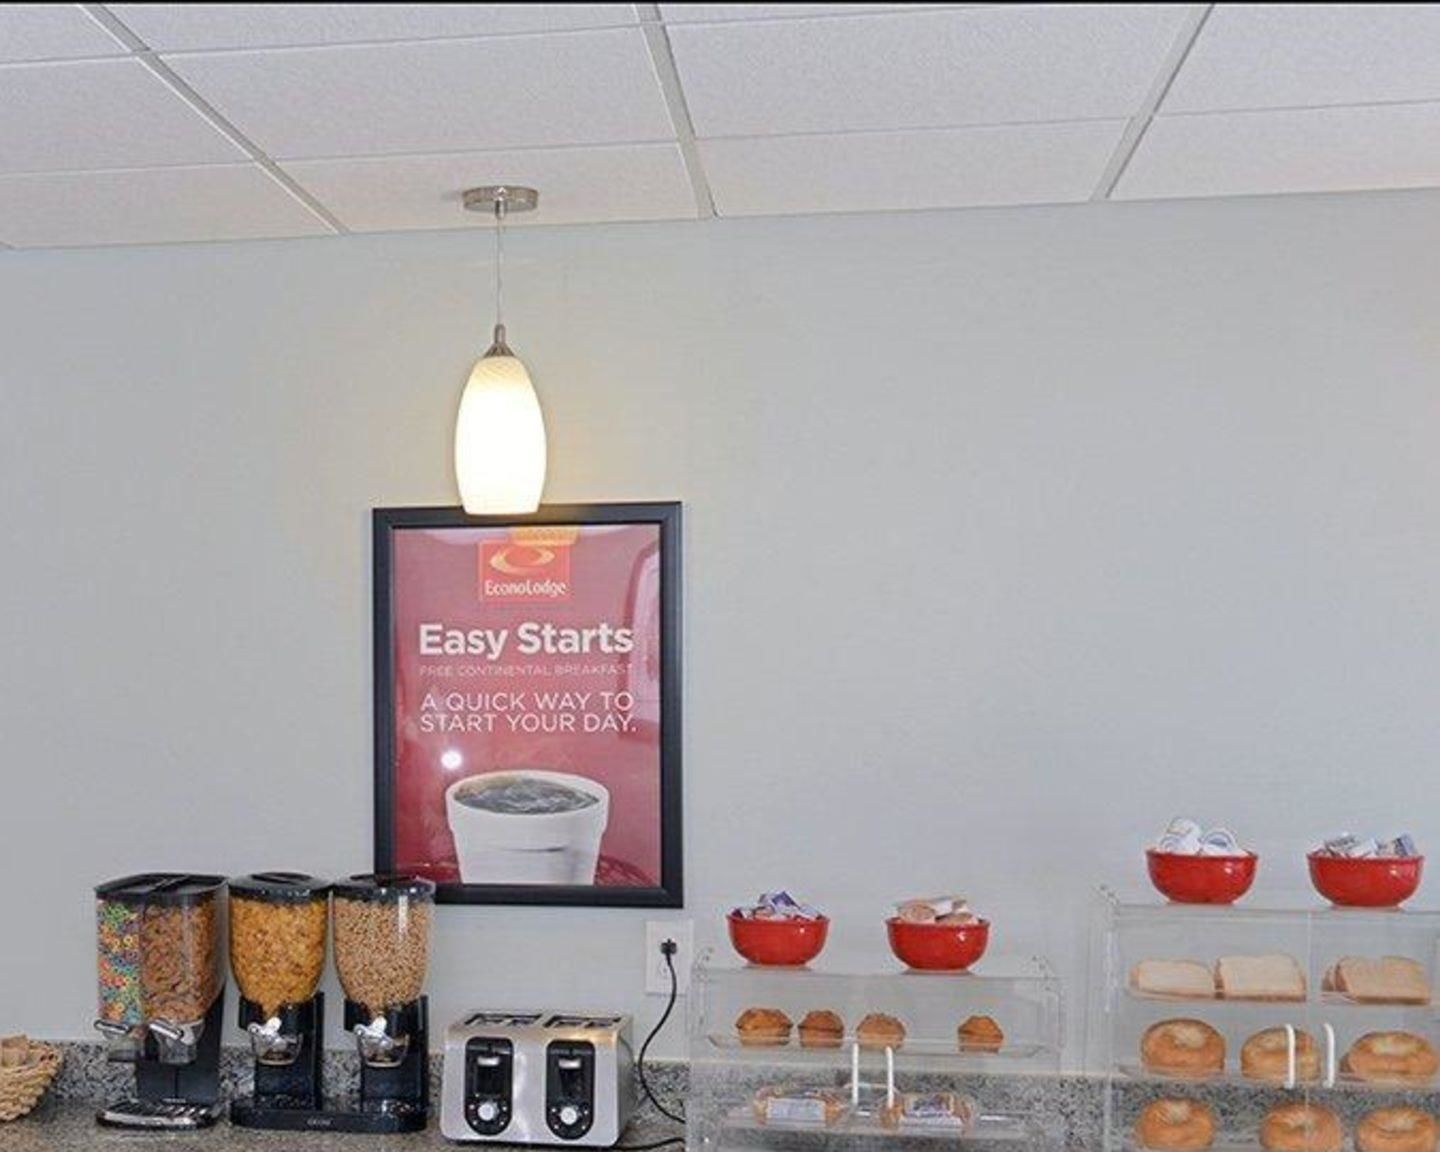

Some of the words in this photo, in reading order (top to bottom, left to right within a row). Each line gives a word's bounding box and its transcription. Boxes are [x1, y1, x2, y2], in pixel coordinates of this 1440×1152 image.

[484, 579, 568, 598] EconoLodge
[419, 622, 509, 660] Easy
[516, 621, 635, 655] Starts
[419, 665, 453, 677] FREE
[458, 664, 548, 677] CONTINENTAL
[554, 663, 633, 676] BREAKFAST
[420, 693, 438, 711] A
[445, 692, 526, 713] QUICK
[533, 692, 592, 711] WAY
[600, 692, 634, 711] TO
[420, 714, 497, 732] START
[506, 714, 575, 732] YOUR
[584, 714, 638, 733] DAY.
